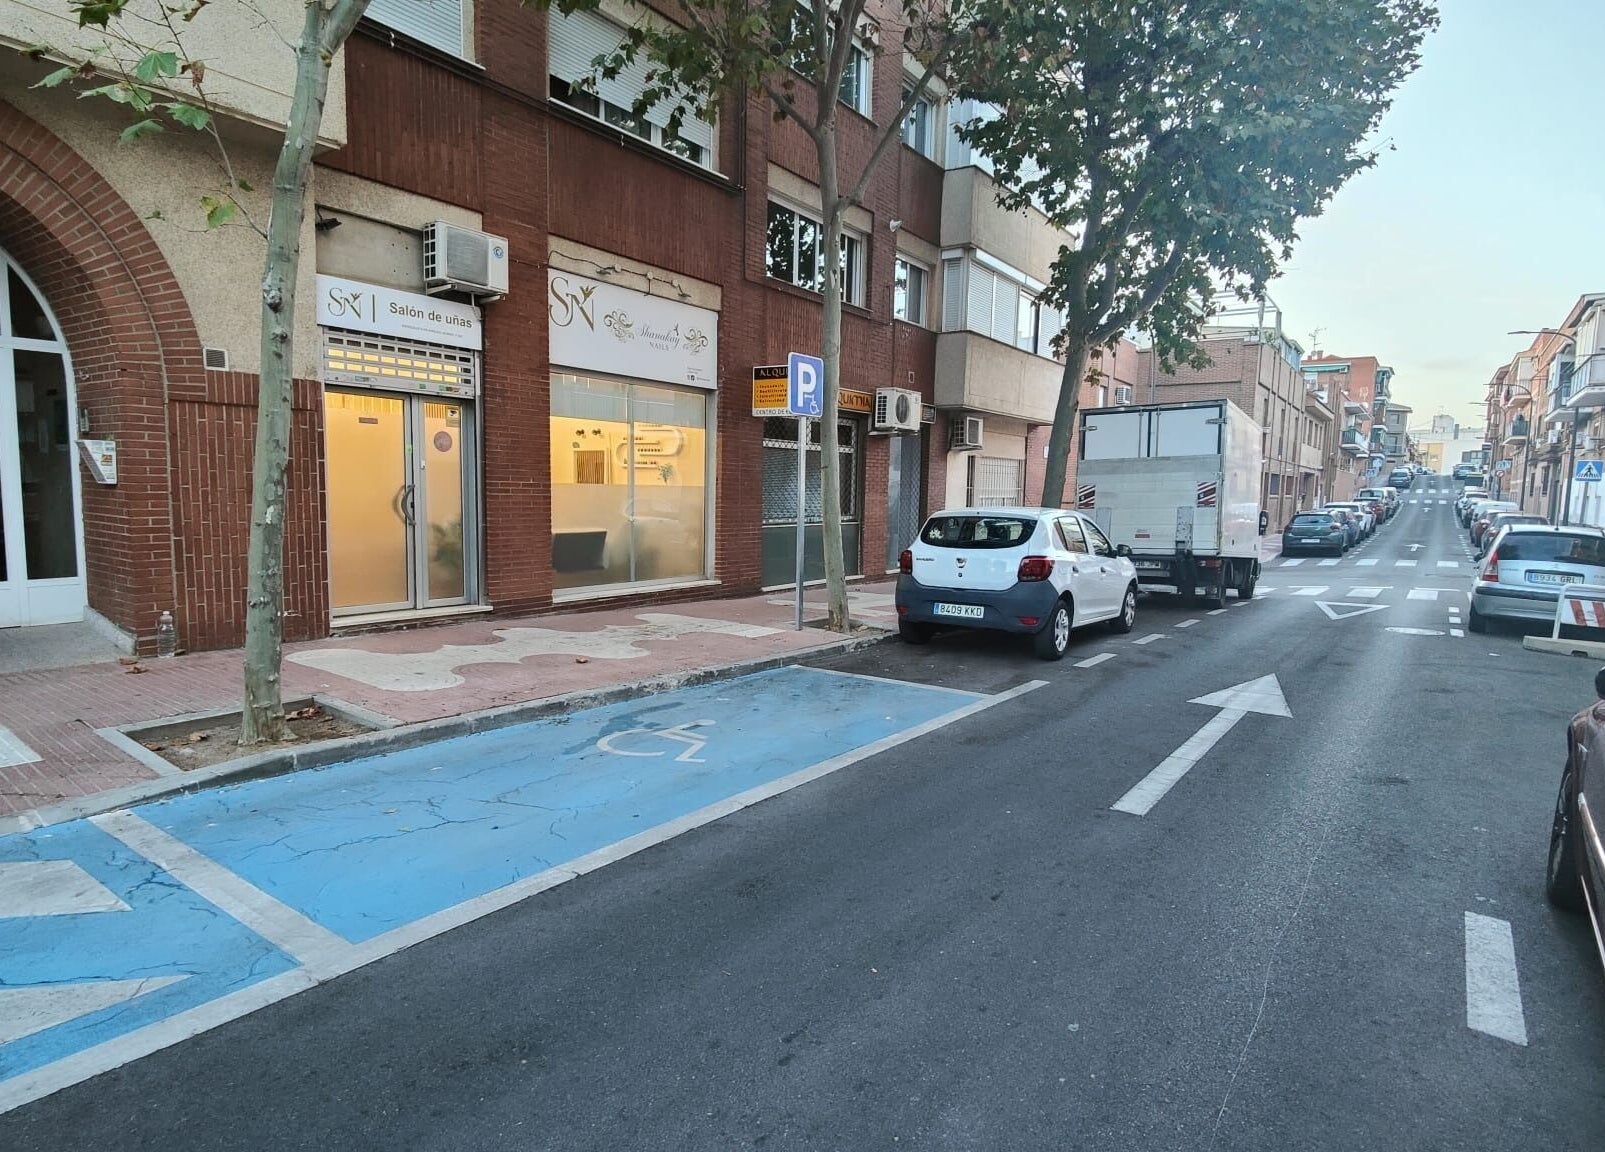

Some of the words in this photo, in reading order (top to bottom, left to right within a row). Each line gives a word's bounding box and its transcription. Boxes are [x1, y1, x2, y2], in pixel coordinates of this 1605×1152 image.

[389, 301, 424, 319] Salón
[427, 310, 442, 322] de
[445, 314, 473, 329] uñas
[649, 341, 670, 351] NAILS
[759, 367, 788, 377] ALQUI
[797, 362, 817, 408] P
[838, 391, 871, 409] QUIMIA
[939, 604, 962, 615] 8409
[964, 607, 982, 617] KKD
